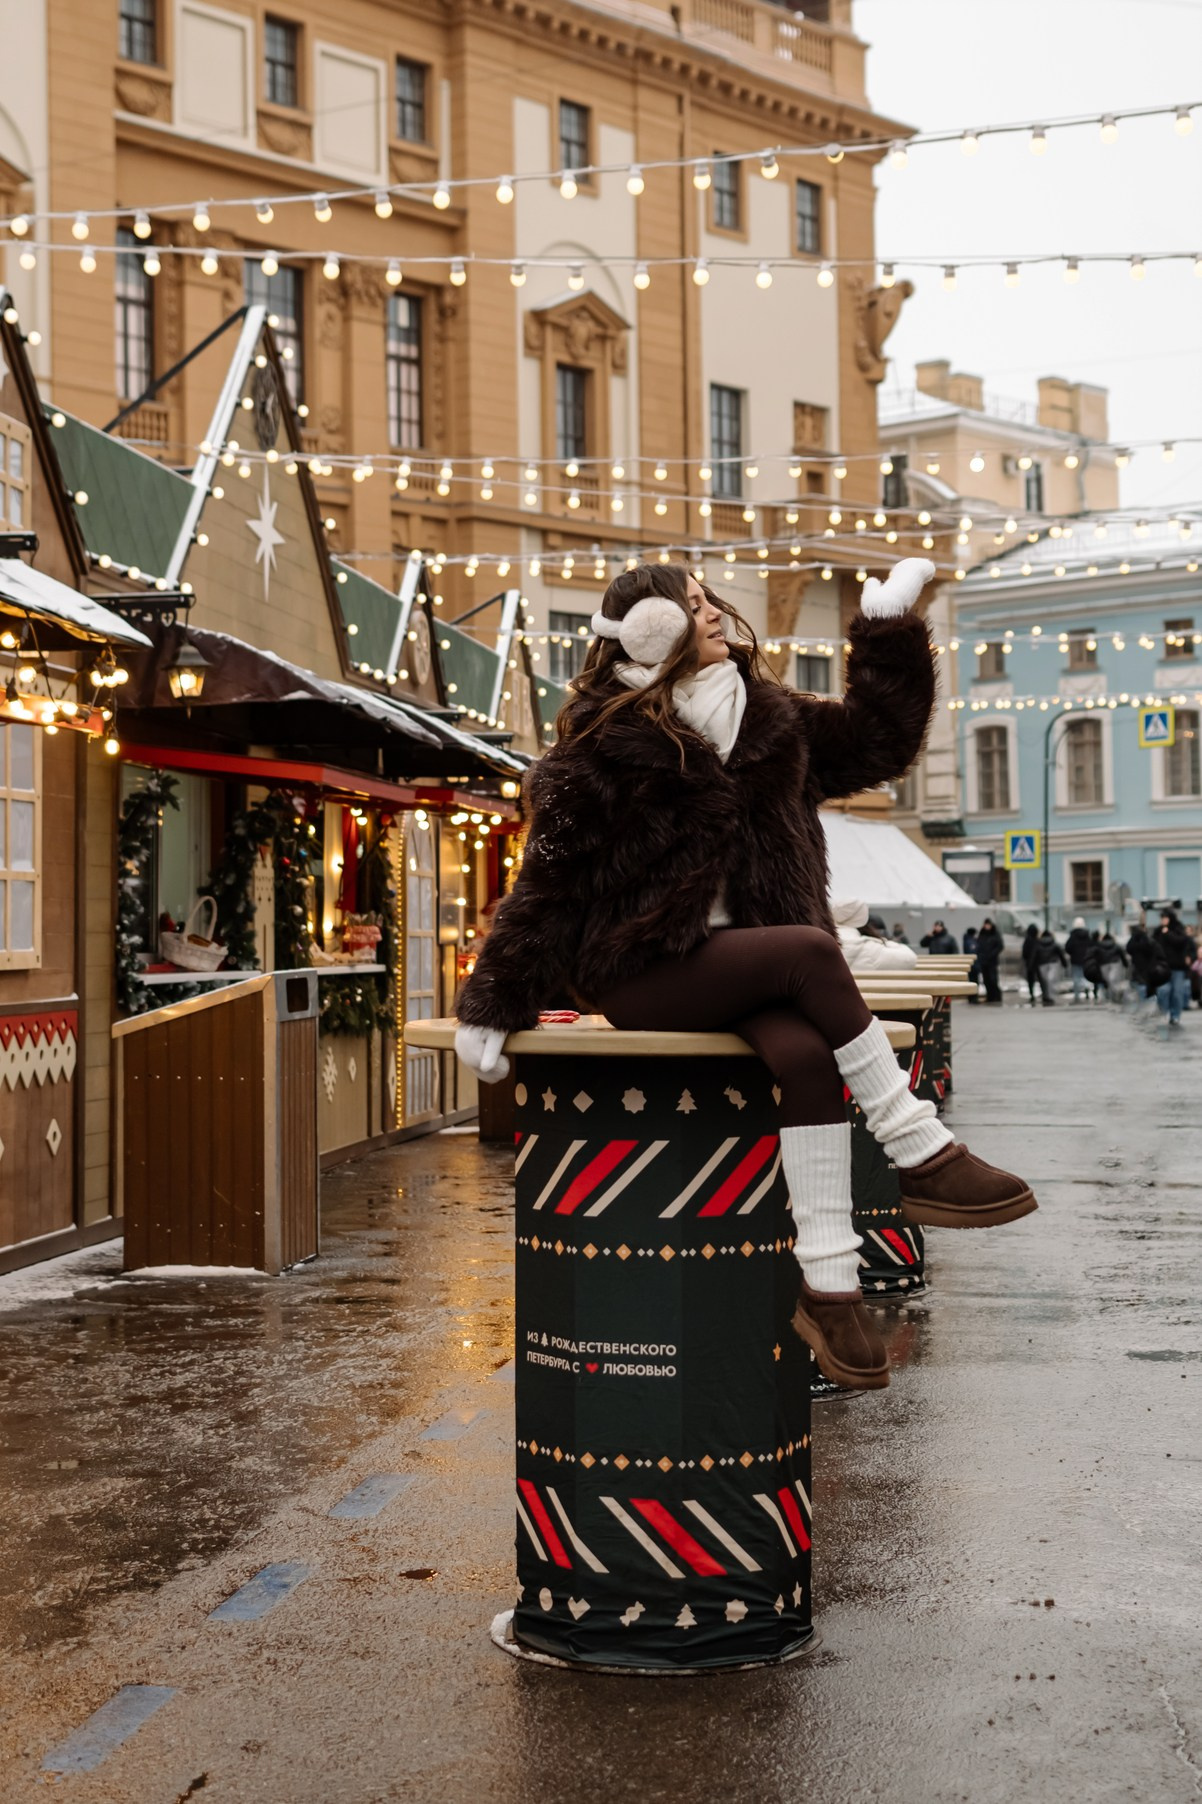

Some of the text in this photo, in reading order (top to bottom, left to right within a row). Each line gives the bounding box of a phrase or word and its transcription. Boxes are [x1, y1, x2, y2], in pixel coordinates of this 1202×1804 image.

[527, 1331, 677, 1356] ИЗ РОЖДЕСТВЕНСКОГО
[527, 1351, 677, 1377] ПЕТЕРБУРГА С ЛЮБОВЬЮ
